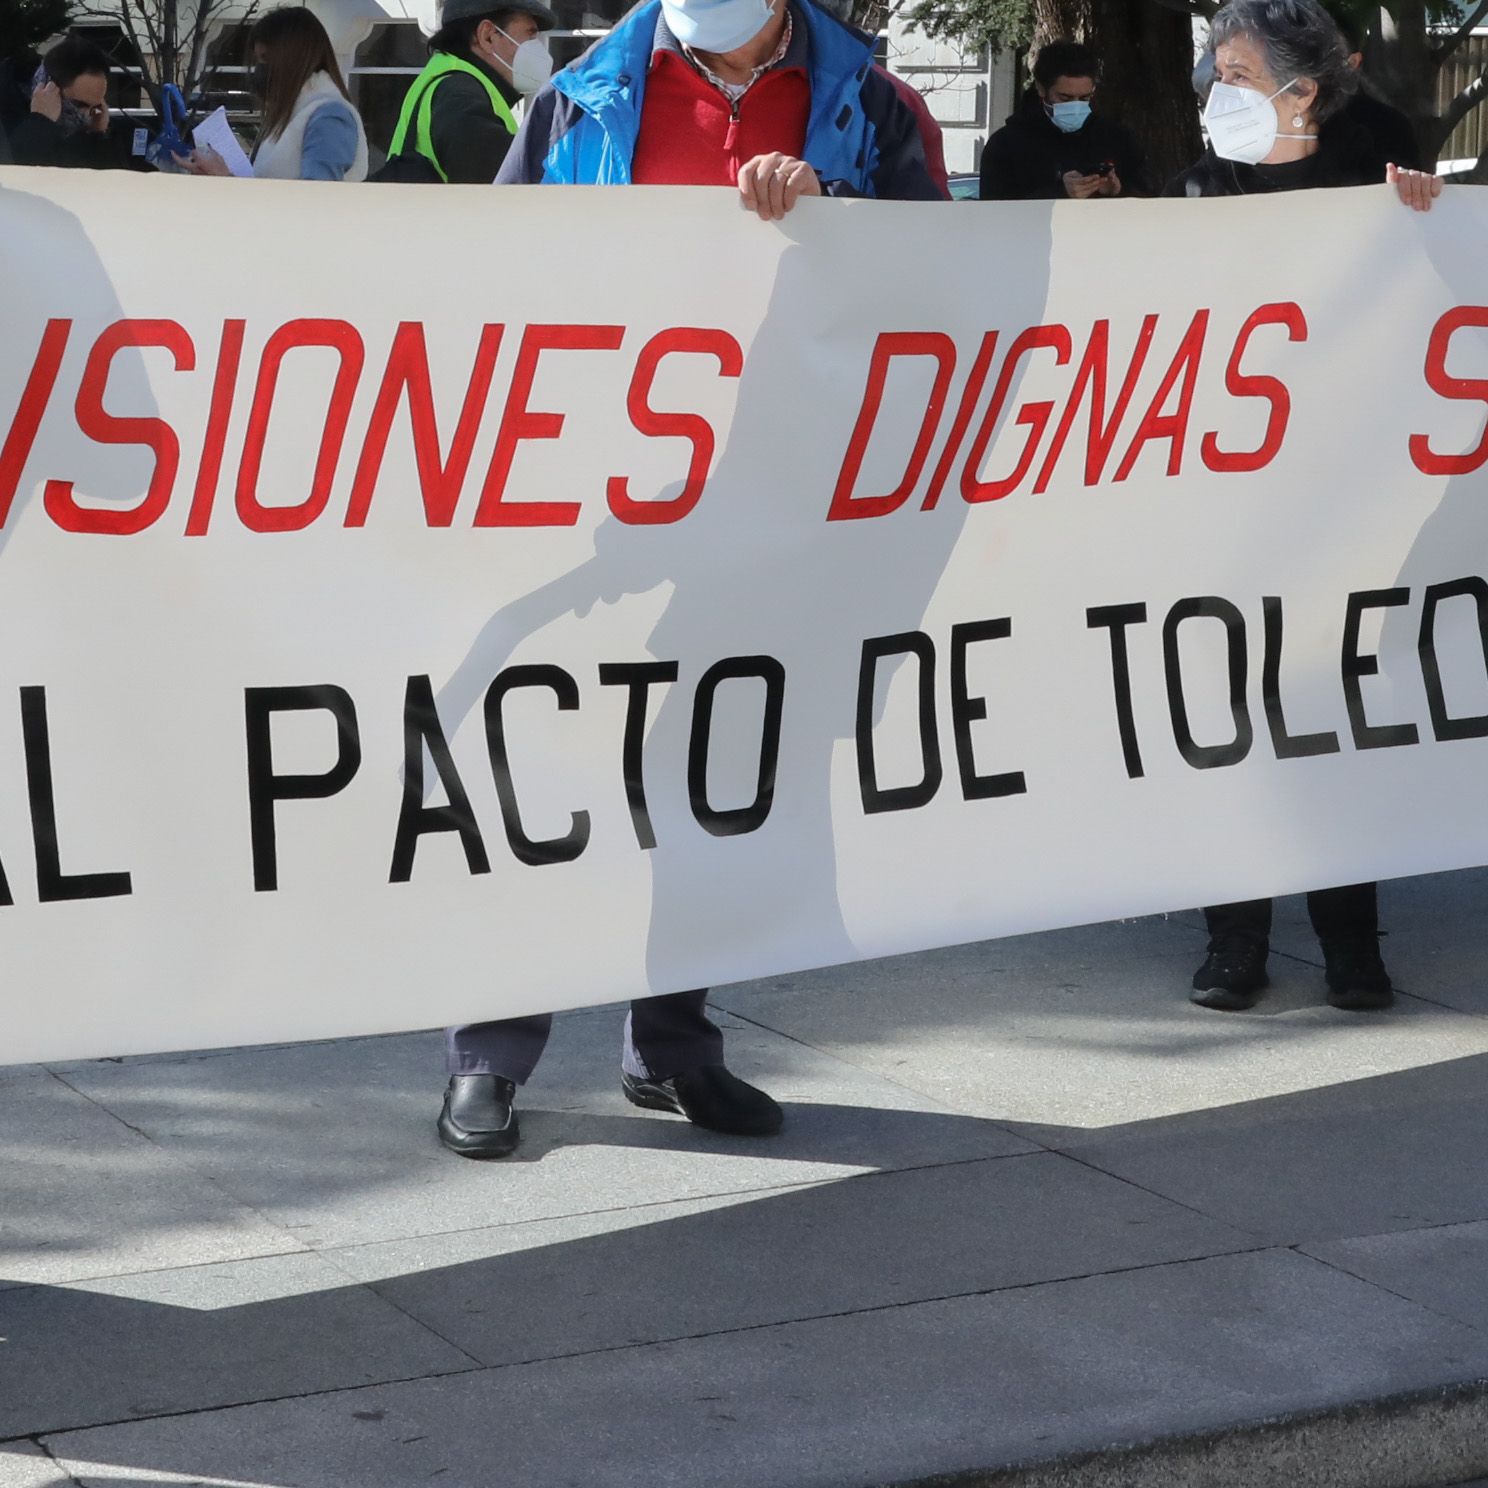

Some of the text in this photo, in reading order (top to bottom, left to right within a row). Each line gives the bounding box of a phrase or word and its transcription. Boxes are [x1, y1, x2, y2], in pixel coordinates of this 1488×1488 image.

[826, 301, 1308, 522] DIGNAS
[244, 653, 786, 892] PACTO
[855, 617, 1028, 815] DE
